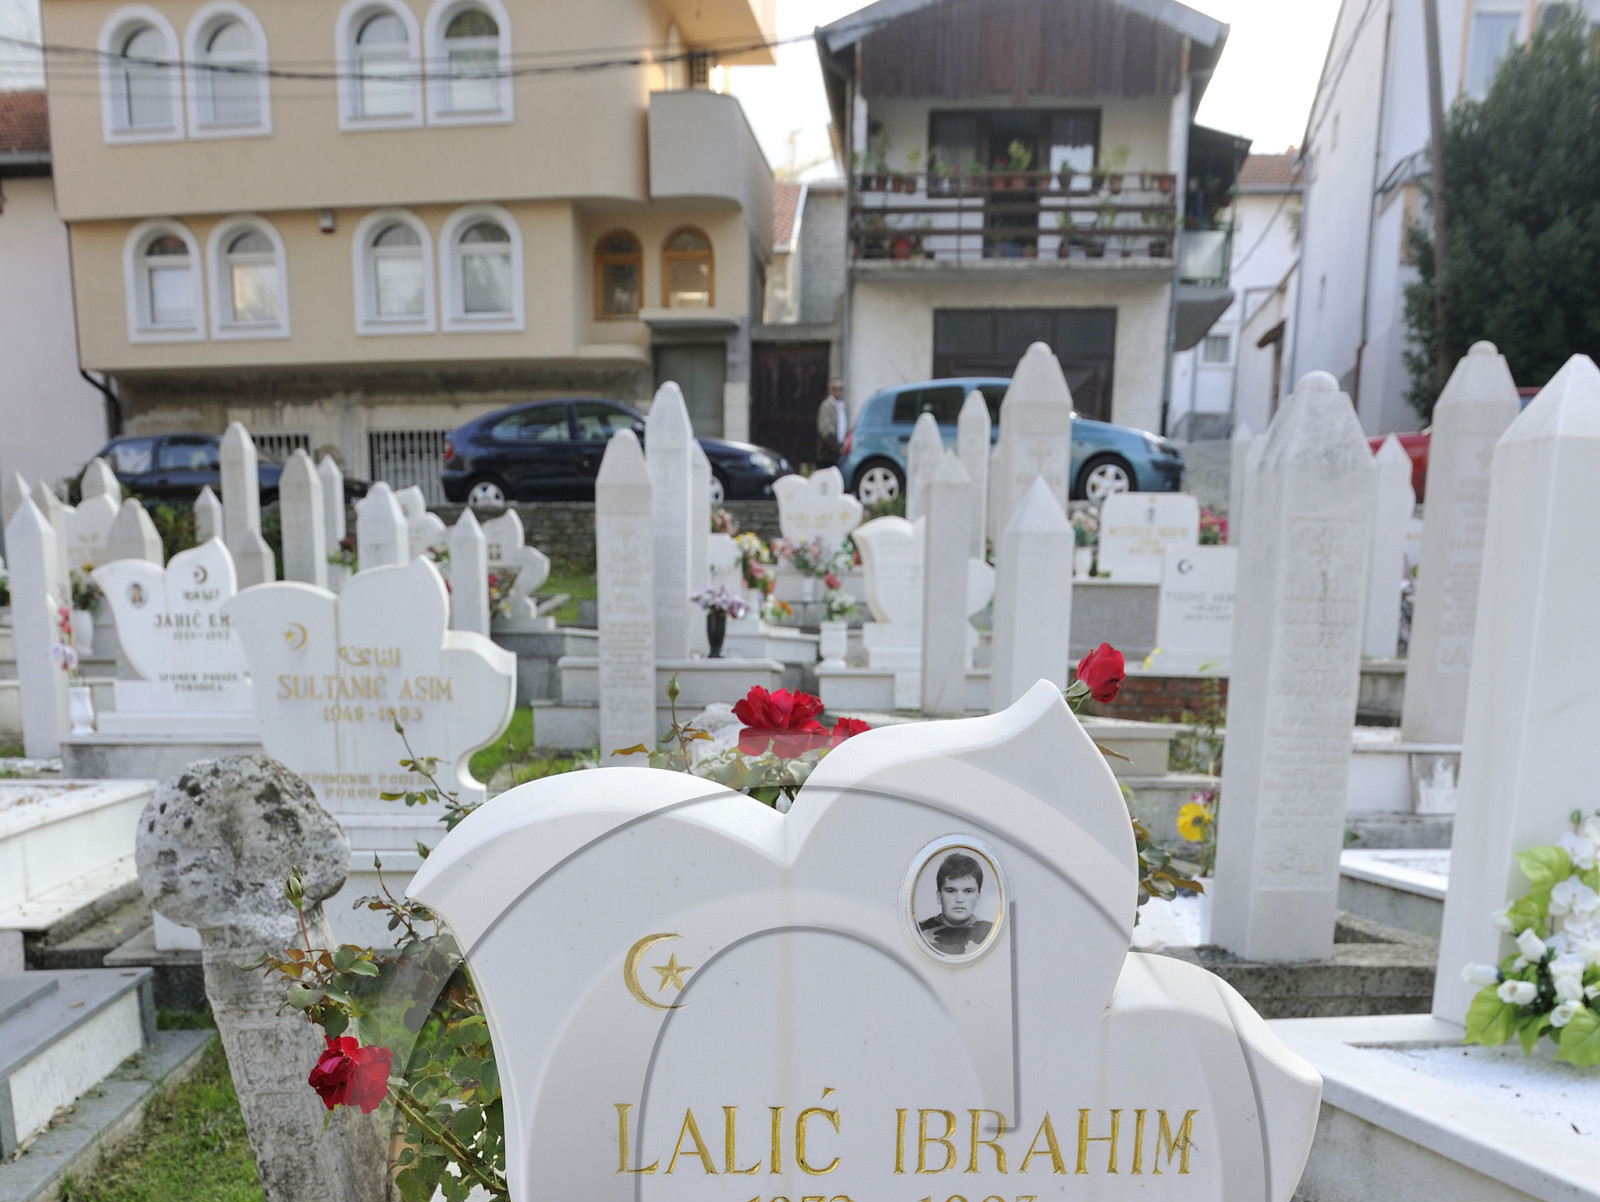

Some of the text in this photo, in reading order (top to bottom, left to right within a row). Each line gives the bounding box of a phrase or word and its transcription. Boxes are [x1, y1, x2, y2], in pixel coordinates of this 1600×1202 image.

[398, 676, 453, 701] ASIM
[613, 1086, 1200, 1177] LALIĆ IBRAHIM
